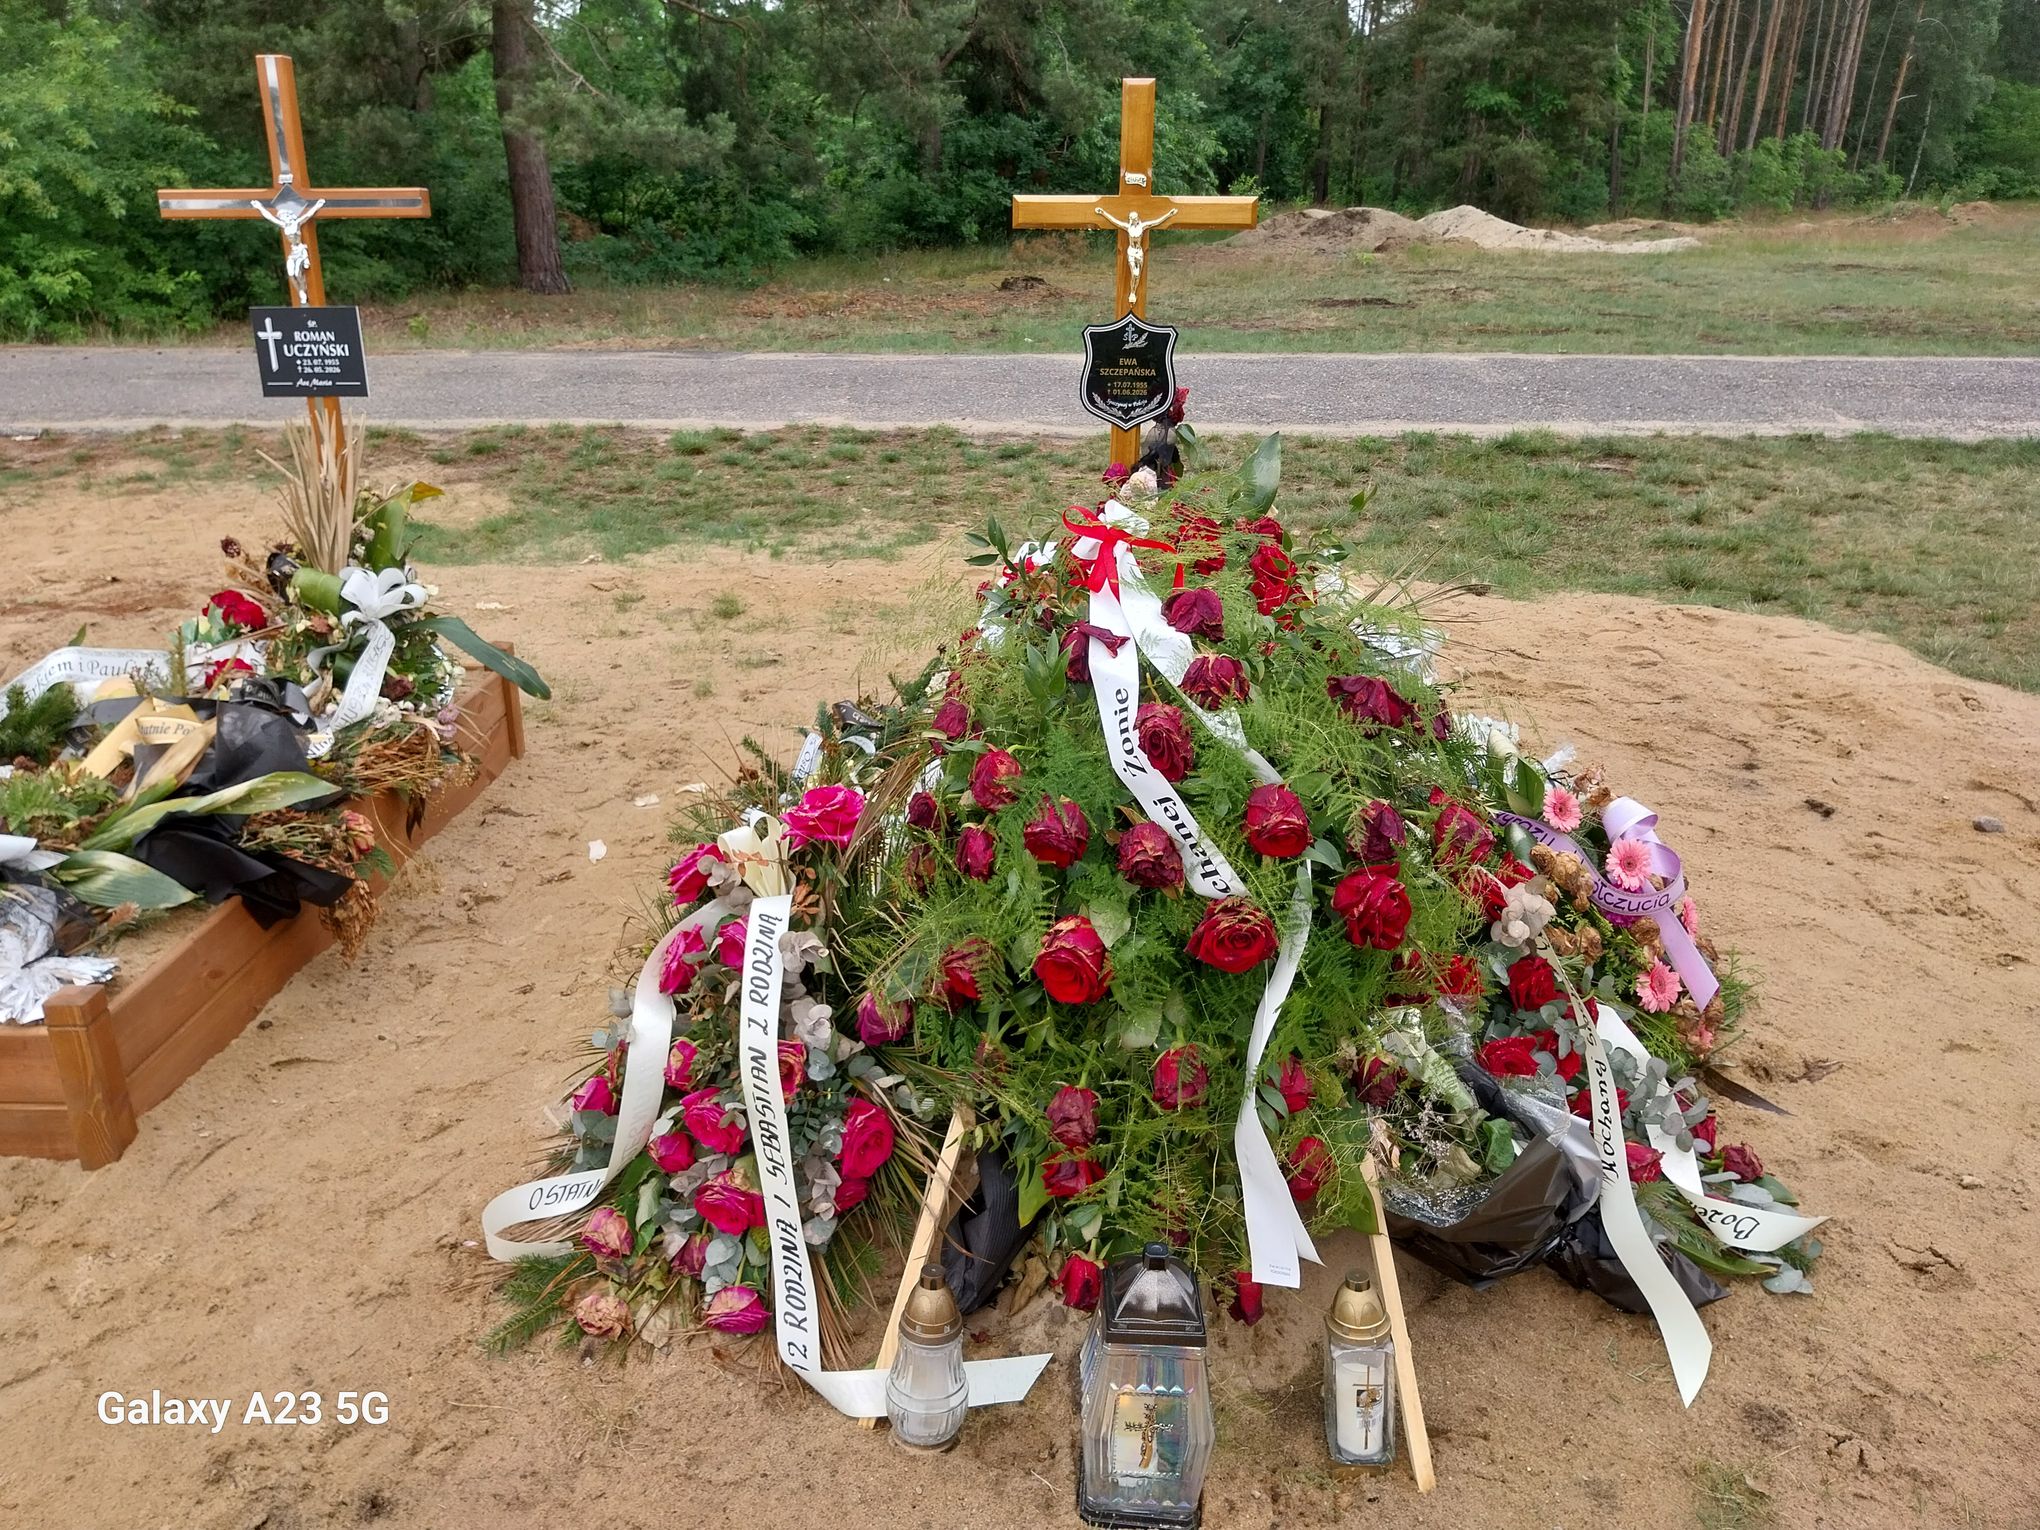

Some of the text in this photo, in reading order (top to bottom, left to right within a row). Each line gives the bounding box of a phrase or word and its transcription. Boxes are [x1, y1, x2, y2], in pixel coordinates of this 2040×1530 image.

[294, 331, 335, 342] ROMAN
[283, 342, 350, 357] UCZYŃSKI
[1119, 358, 1138, 366] EWA
[1099, 366, 1157, 377] SZCZEPAŃSKA
[1113, 687, 1233, 895] chanej Żonie
[749, 1046, 788, 1186] SEBASTIAN
